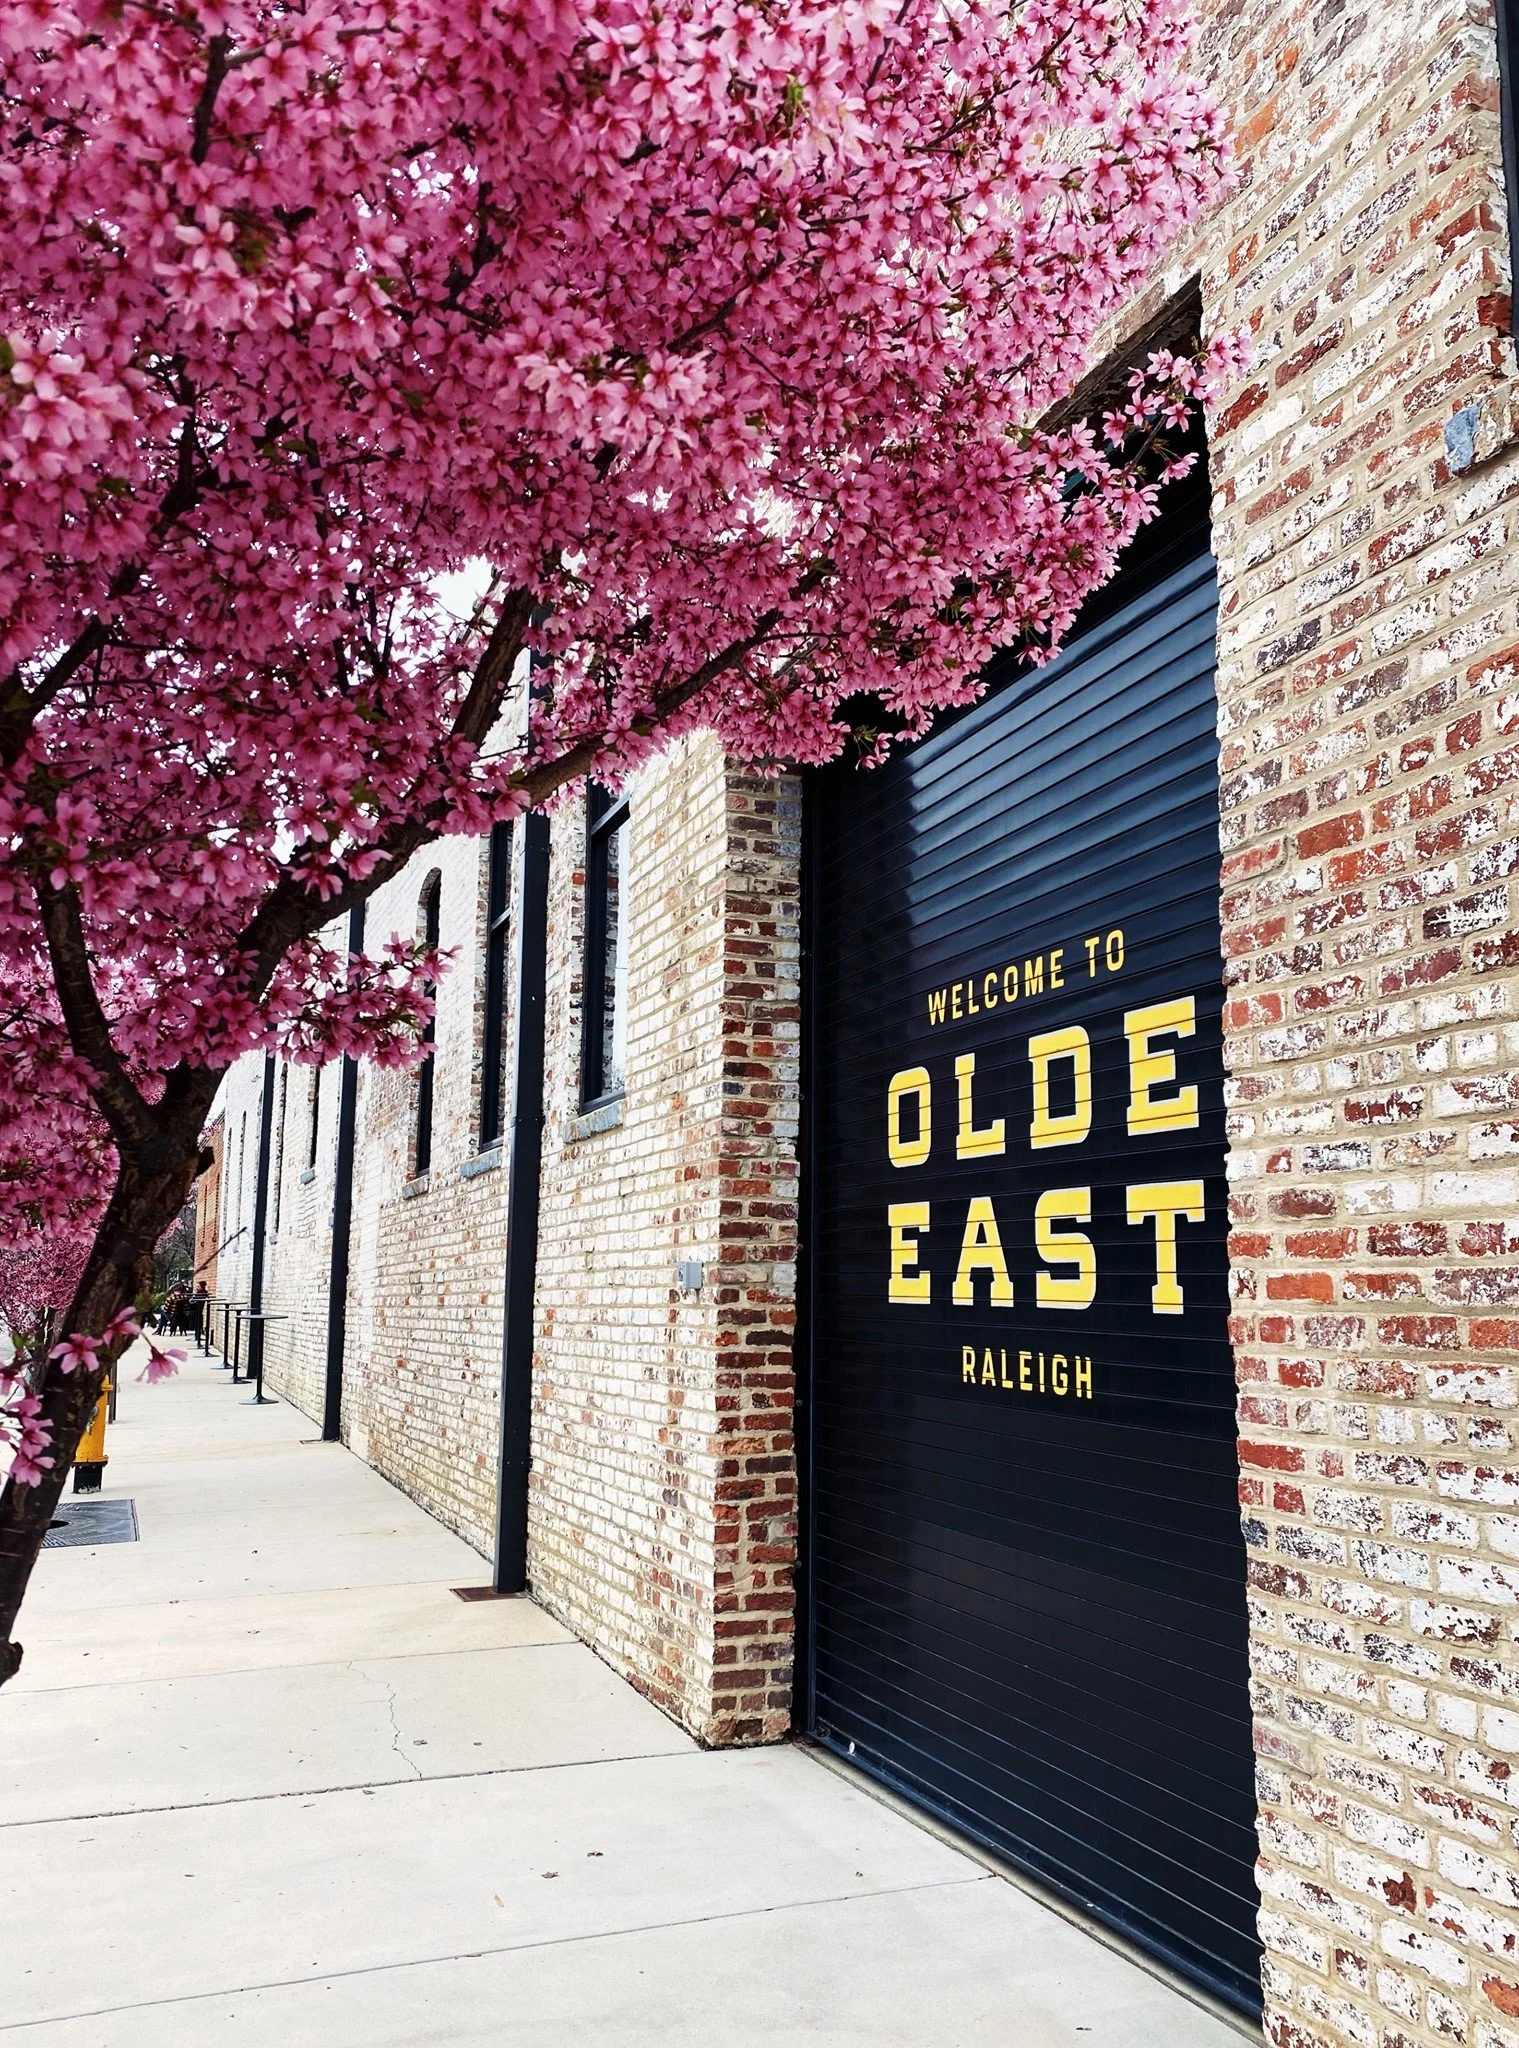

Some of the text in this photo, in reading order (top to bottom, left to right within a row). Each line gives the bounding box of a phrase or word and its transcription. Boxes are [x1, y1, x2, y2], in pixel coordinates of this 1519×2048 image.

[927, 929, 1126, 1026] WELCOME TO
[887, 995, 1200, 1169] OLDE
[887, 1179, 1206, 1315] EAST
[962, 1345, 1093, 1400] RALEIGH
